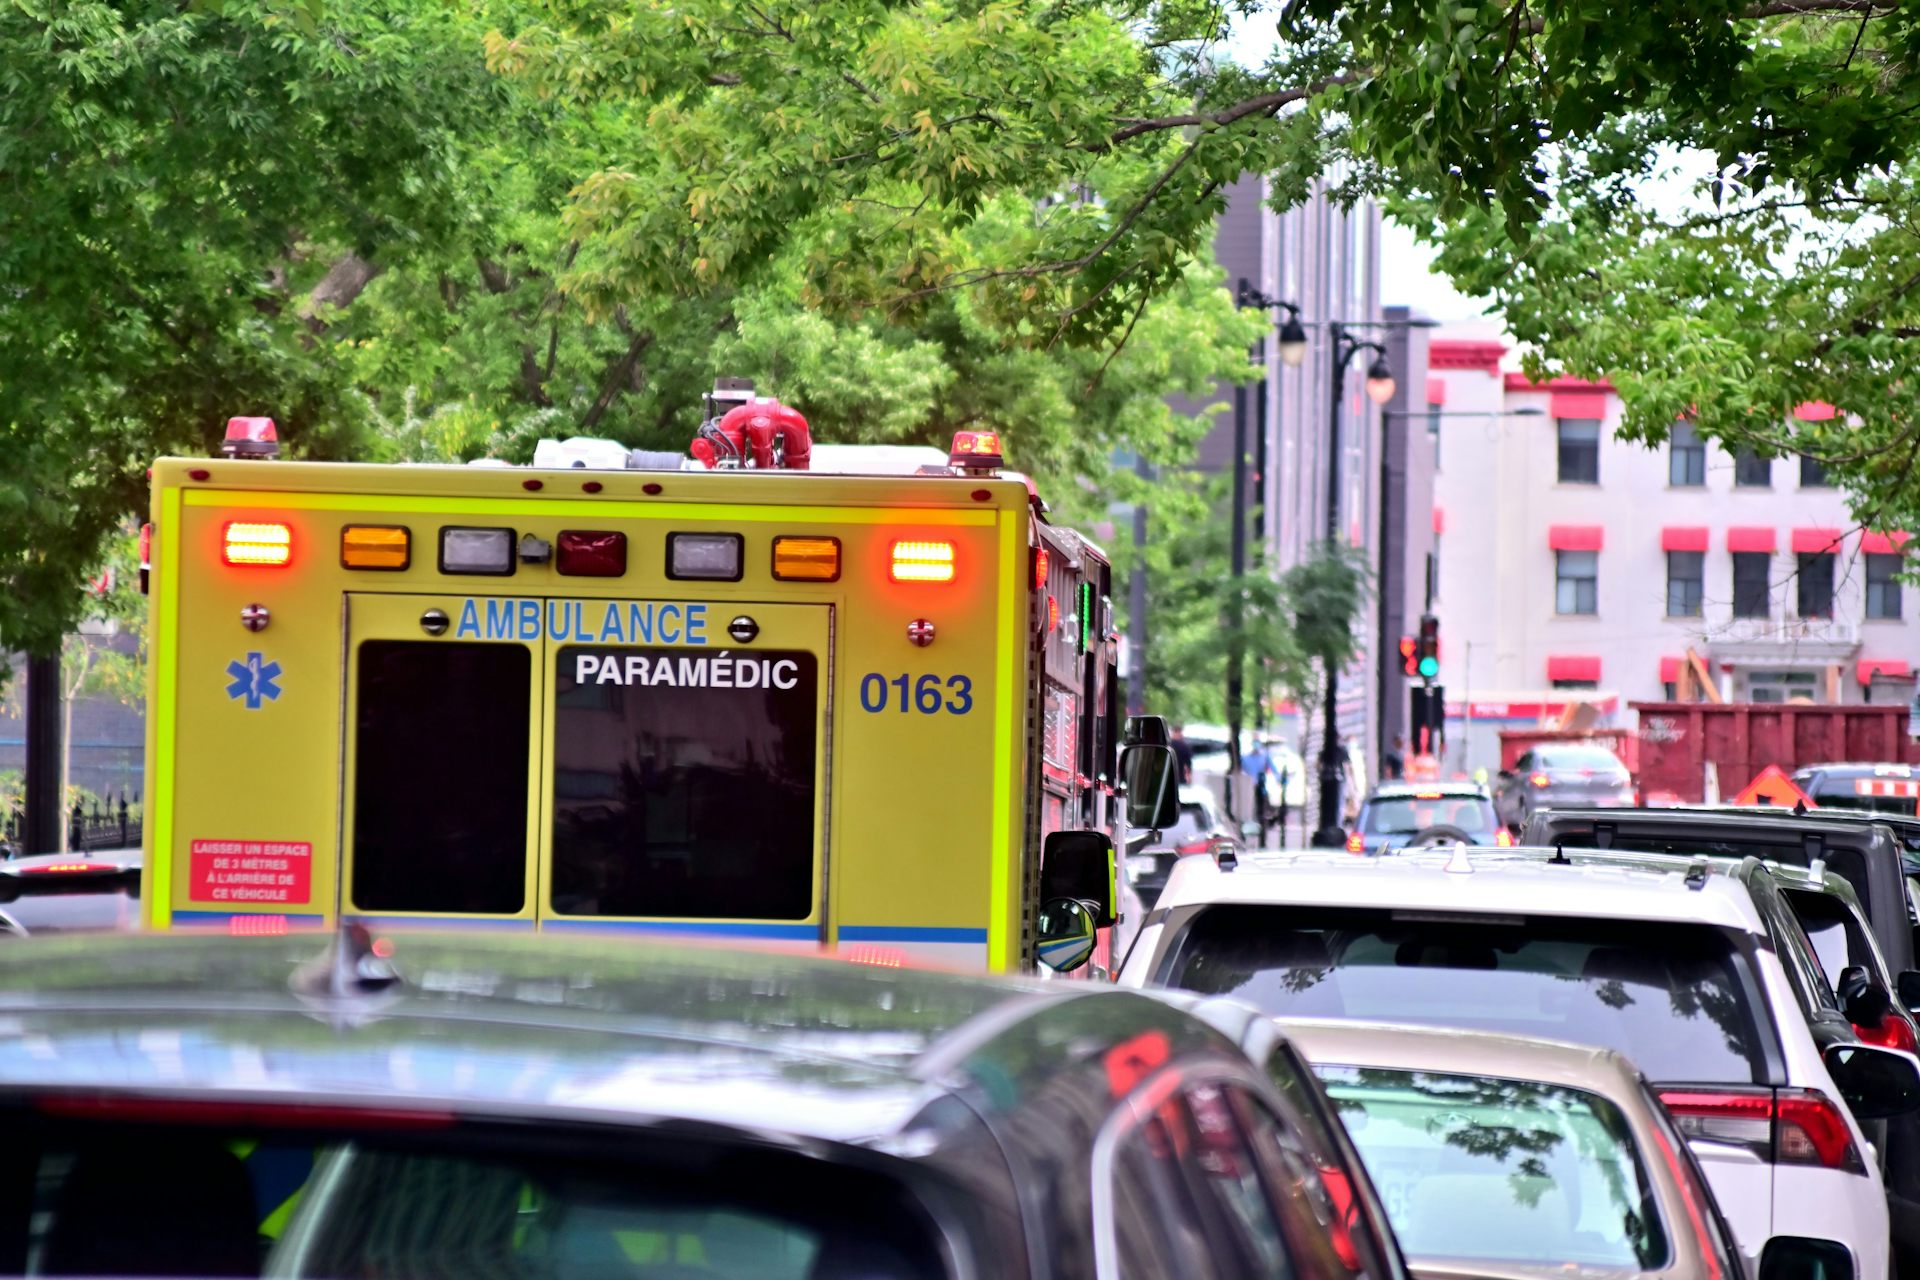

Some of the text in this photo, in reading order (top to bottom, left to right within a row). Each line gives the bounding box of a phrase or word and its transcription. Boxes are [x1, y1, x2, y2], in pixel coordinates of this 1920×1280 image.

[456, 599, 707, 644] AMBULANCE
[576, 651, 798, 690] PARAMÉDIC
[860, 672, 973, 715] 0163
[194, 842, 309, 856] LAISSER UN ESPACE
[213, 856, 288, 870] DE 3 MÈTRES
[206, 869, 295, 886] À L'ARRIÈRE DE
[212, 885, 288, 901] CE VÉHICULE
